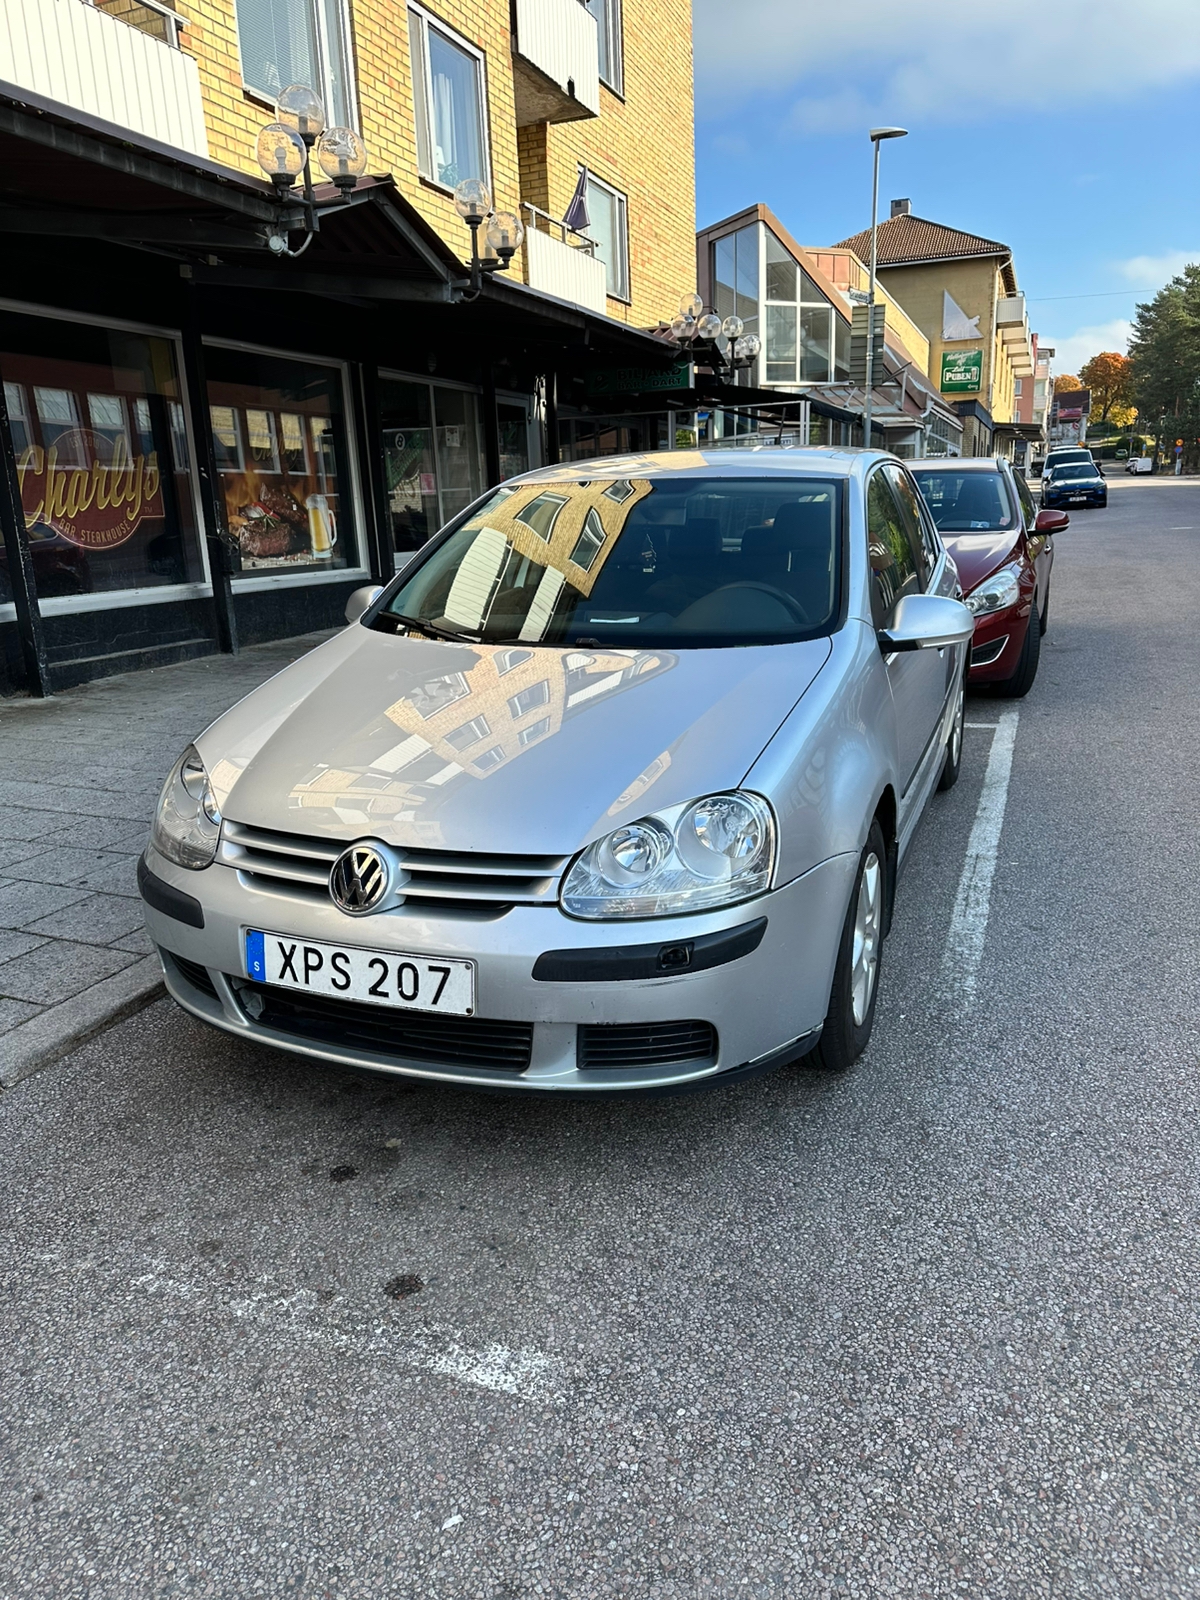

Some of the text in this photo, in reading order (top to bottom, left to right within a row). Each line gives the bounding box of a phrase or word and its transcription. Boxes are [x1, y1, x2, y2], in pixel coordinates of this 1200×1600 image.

[617, 366, 683, 381] BILJARD
[945, 371, 972, 381] PUBEN
[617, 377, 683, 391] BAR DART
[16, 433, 161, 528] Charlys
[58, 518, 131, 544] BAR STEAKHOUSE
[253, 961, 261, 972] S
[277, 941, 452, 1006] XPS 207
